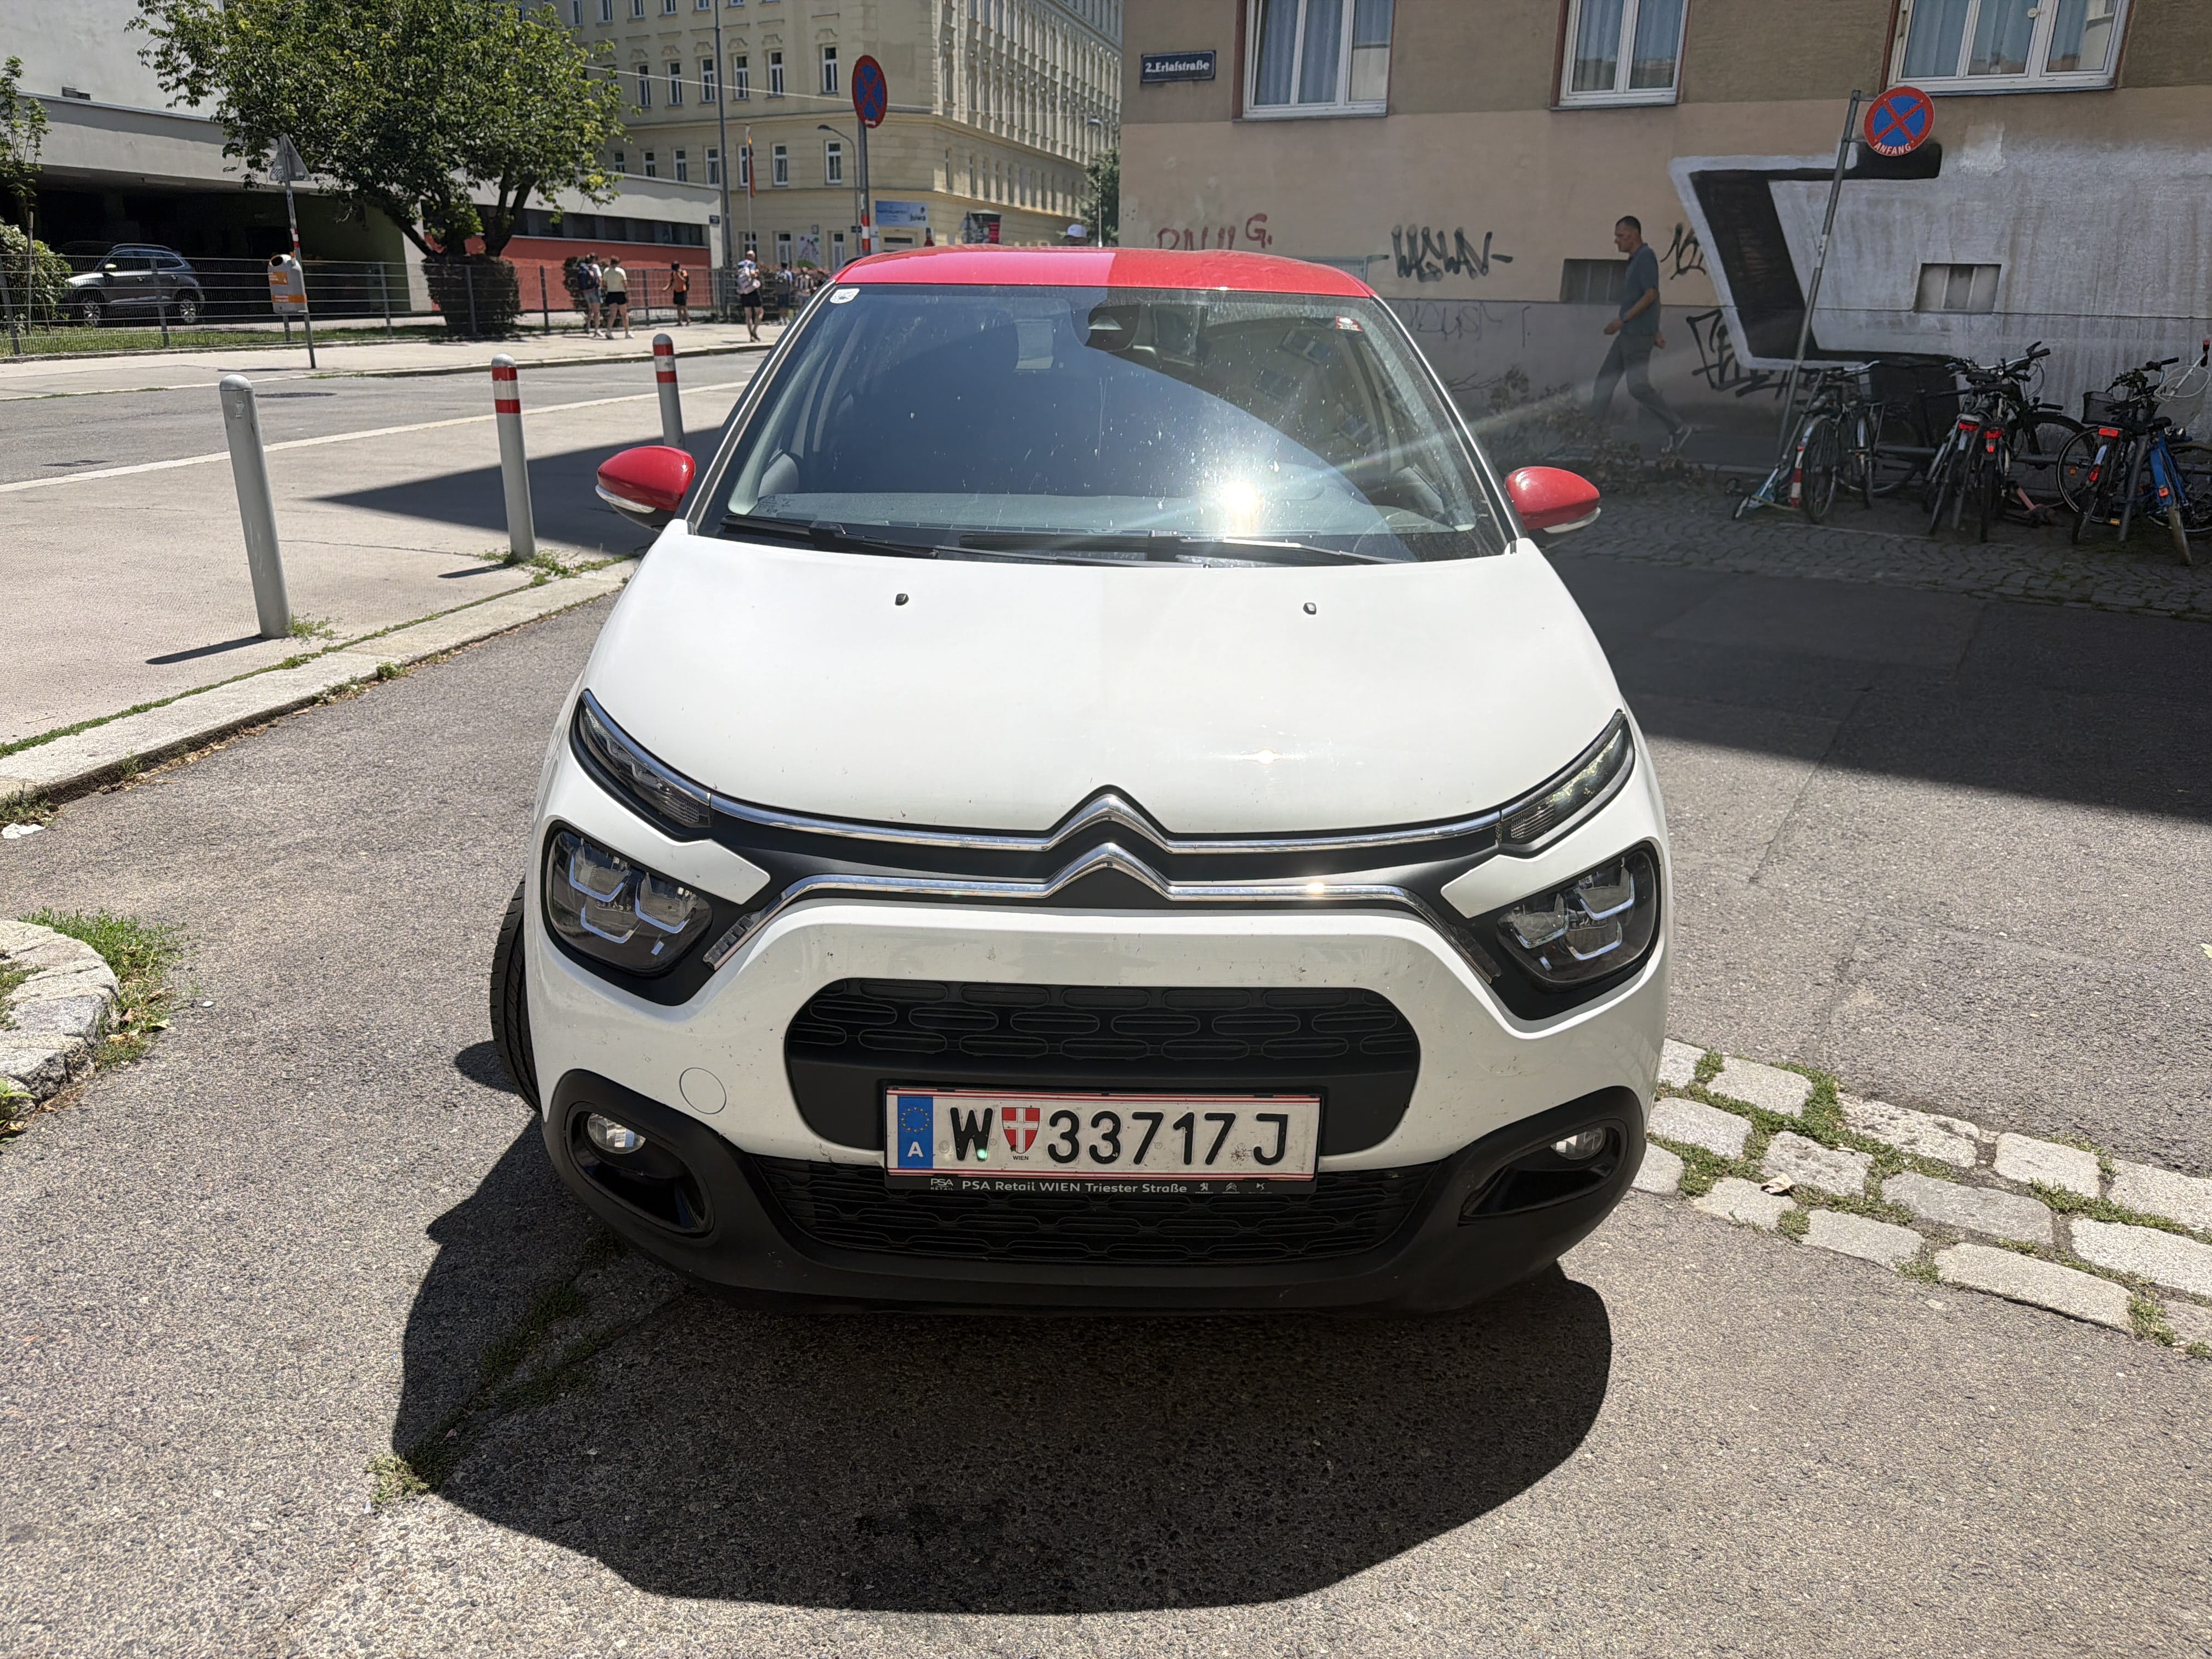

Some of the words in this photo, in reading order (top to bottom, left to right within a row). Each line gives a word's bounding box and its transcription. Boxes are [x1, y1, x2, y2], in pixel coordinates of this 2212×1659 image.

[1874, 142, 1911, 154] ANFANG
[950, 1107, 994, 1161] W
[907, 1141, 924, 1158] A
[930, 1178, 953, 1186] PSA
[962, 1181, 991, 1190] PSA
[995, 1181, 1036, 1191] Retail
[1039, 1182, 1080, 1192] WIEN
[1085, 1183, 1138, 1193] Triester
[1142, 1183, 1188, 1193] Straße
